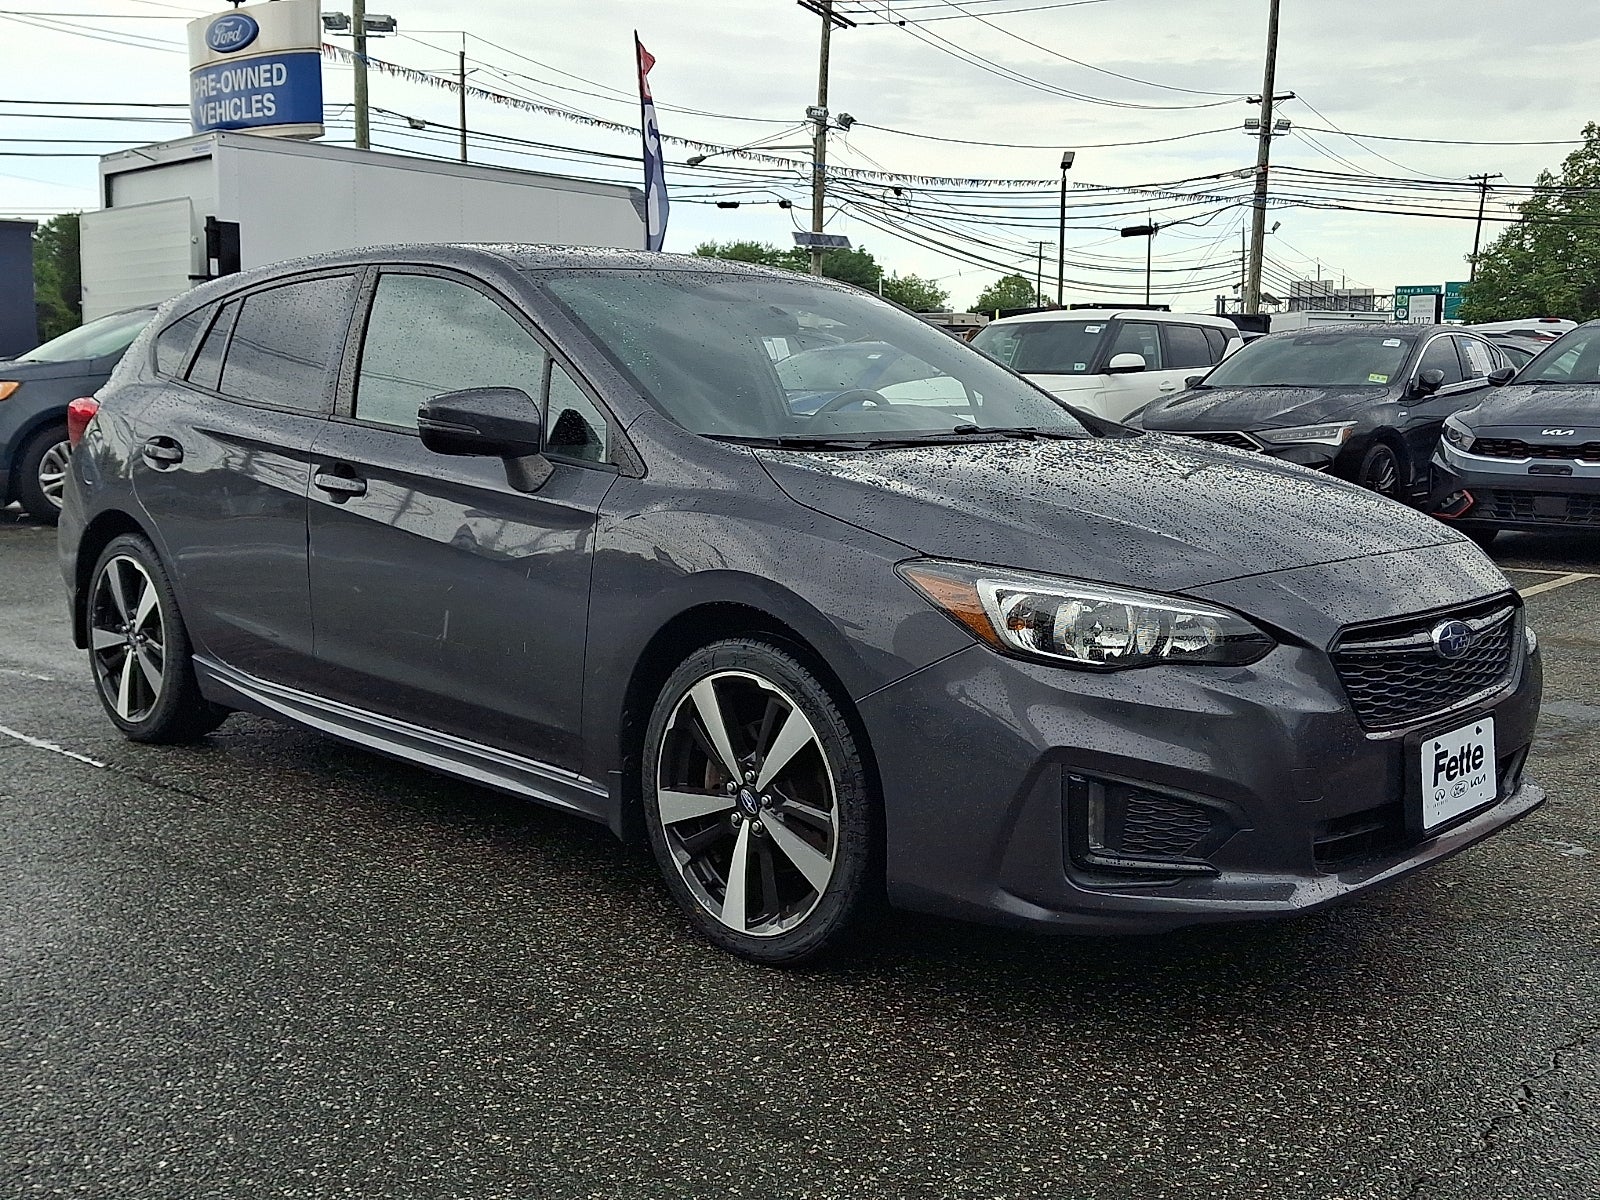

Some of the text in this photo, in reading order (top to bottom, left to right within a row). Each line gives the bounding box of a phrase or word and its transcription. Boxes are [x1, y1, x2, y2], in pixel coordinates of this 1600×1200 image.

[213, 21, 243, 46] Ford
[194, 63, 288, 99] PRE-OWNED
[199, 93, 277, 126] VEHICLES
[1432, 742, 1484, 788] Fette
[1452, 782, 1467, 797] Ford
